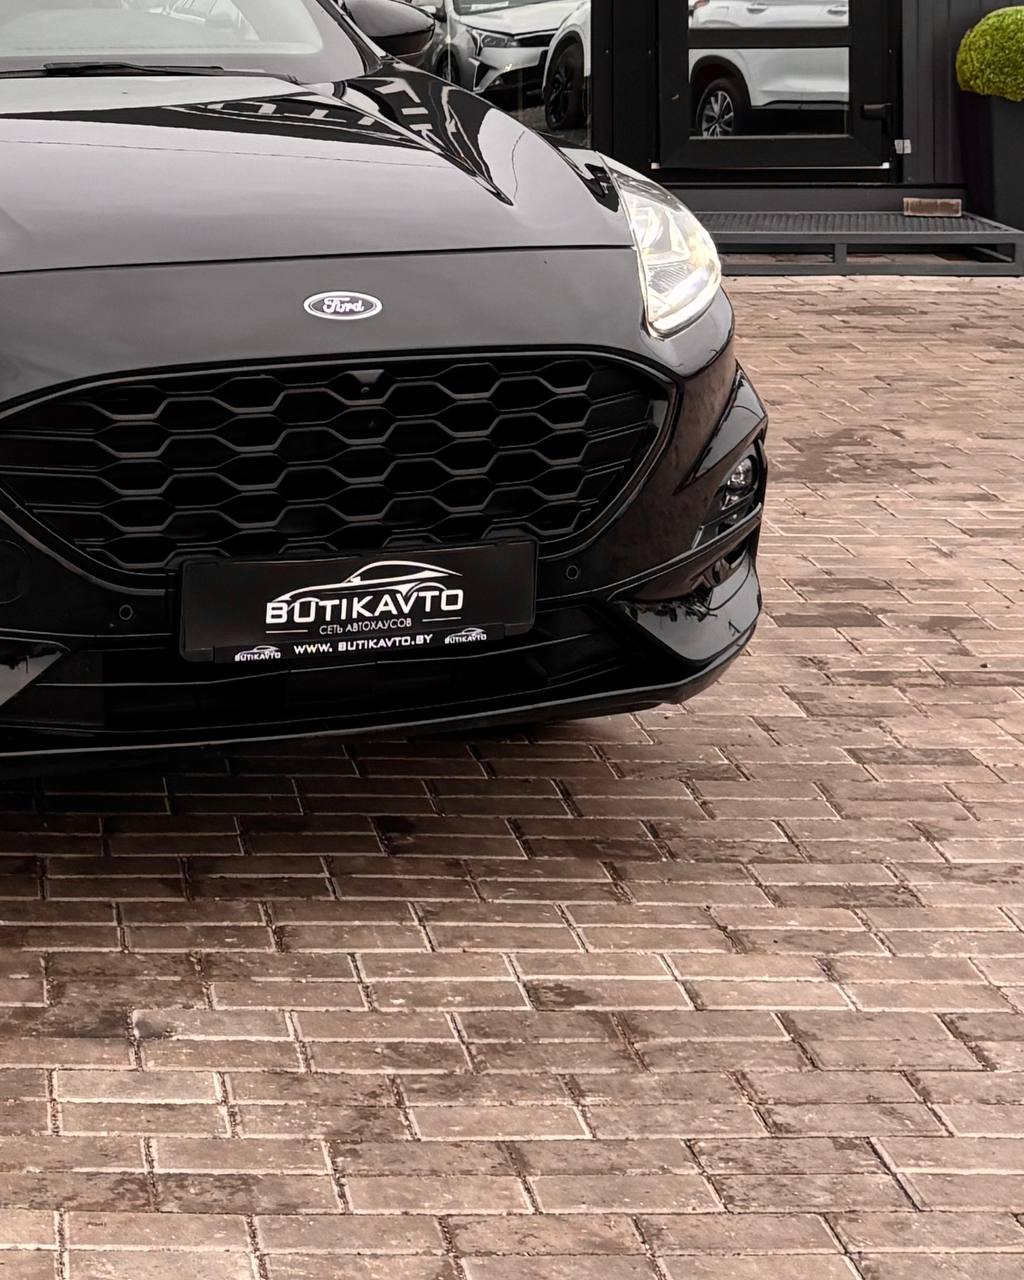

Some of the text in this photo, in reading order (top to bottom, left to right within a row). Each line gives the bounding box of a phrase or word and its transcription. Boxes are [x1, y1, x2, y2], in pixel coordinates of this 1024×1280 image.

[322, 297, 365, 313] Ford
[265, 589, 465, 625] BUTIKAVTO
[319, 617, 413, 635] СЕТЬ АВТОХАУСОВ
[293, 634, 434, 655] WWW. BUTIKAVTO.BY
[444, 633, 487, 645] BUTIKAVTO
[234, 651, 282, 662] BUTIKAVTO
